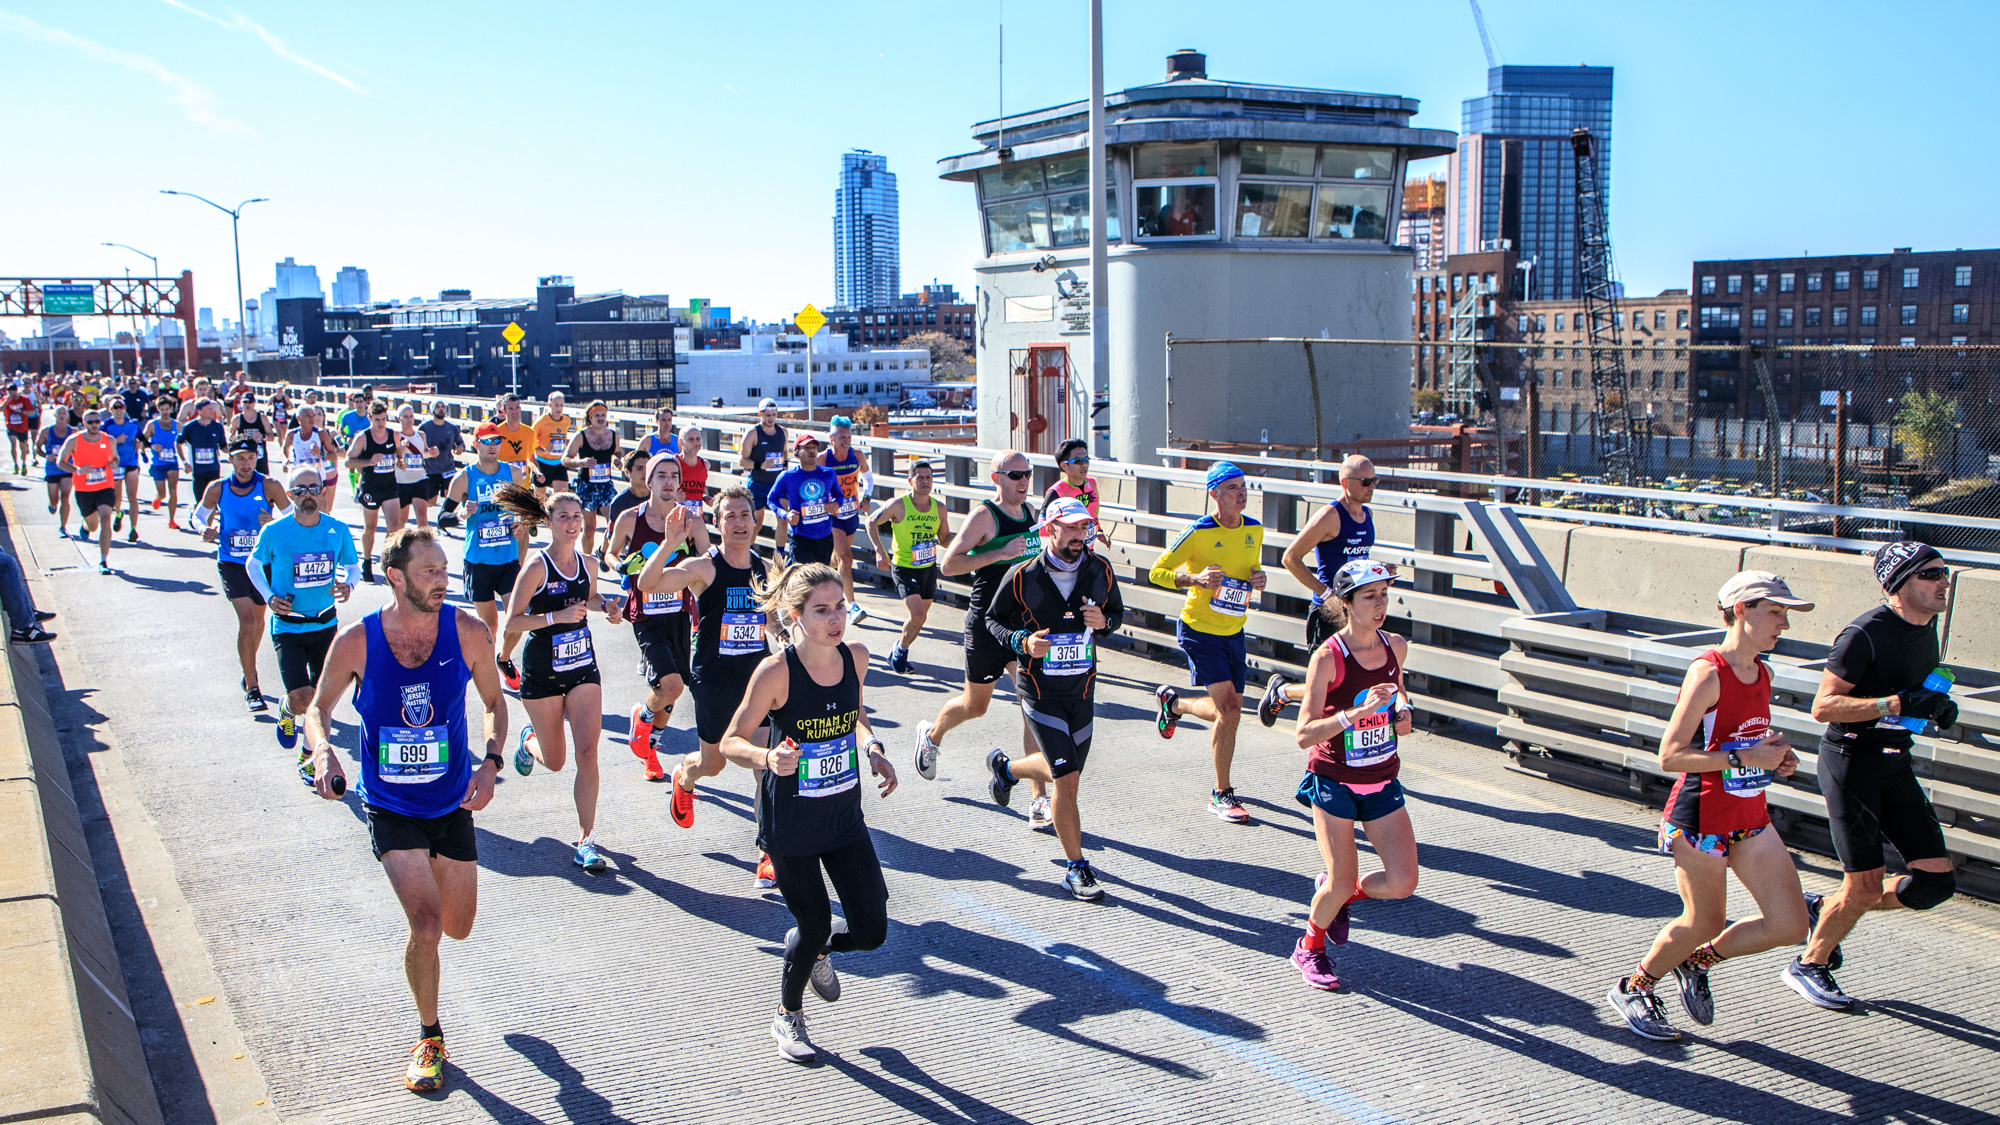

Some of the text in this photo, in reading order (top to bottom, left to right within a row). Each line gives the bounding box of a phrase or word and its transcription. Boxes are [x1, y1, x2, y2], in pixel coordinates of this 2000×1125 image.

[283, 333, 298, 345] BOX
[279, 344, 304, 358] HOUSE
[808, 505, 823, 515] 5873
[304, 562, 326, 574] 4472
[1224, 589, 1243, 603] 5410
[733, 625, 756, 640] 5342
[564, 641, 582, 656] 4157
[1057, 646, 1079, 661] 3751
[405, 684, 426, 694] NORTH
[407, 692, 426, 701] JERSEY
[796, 709, 859, 731] GOTHAM CITY
[1358, 713, 1387, 728] EMILY
[1738, 716, 1770, 732] MOHEGAN
[806, 721, 851, 739] RUNNERS
[1361, 727, 1385, 747] 6154
[400, 744, 428, 763] 699
[820, 755, 843, 776] 826
